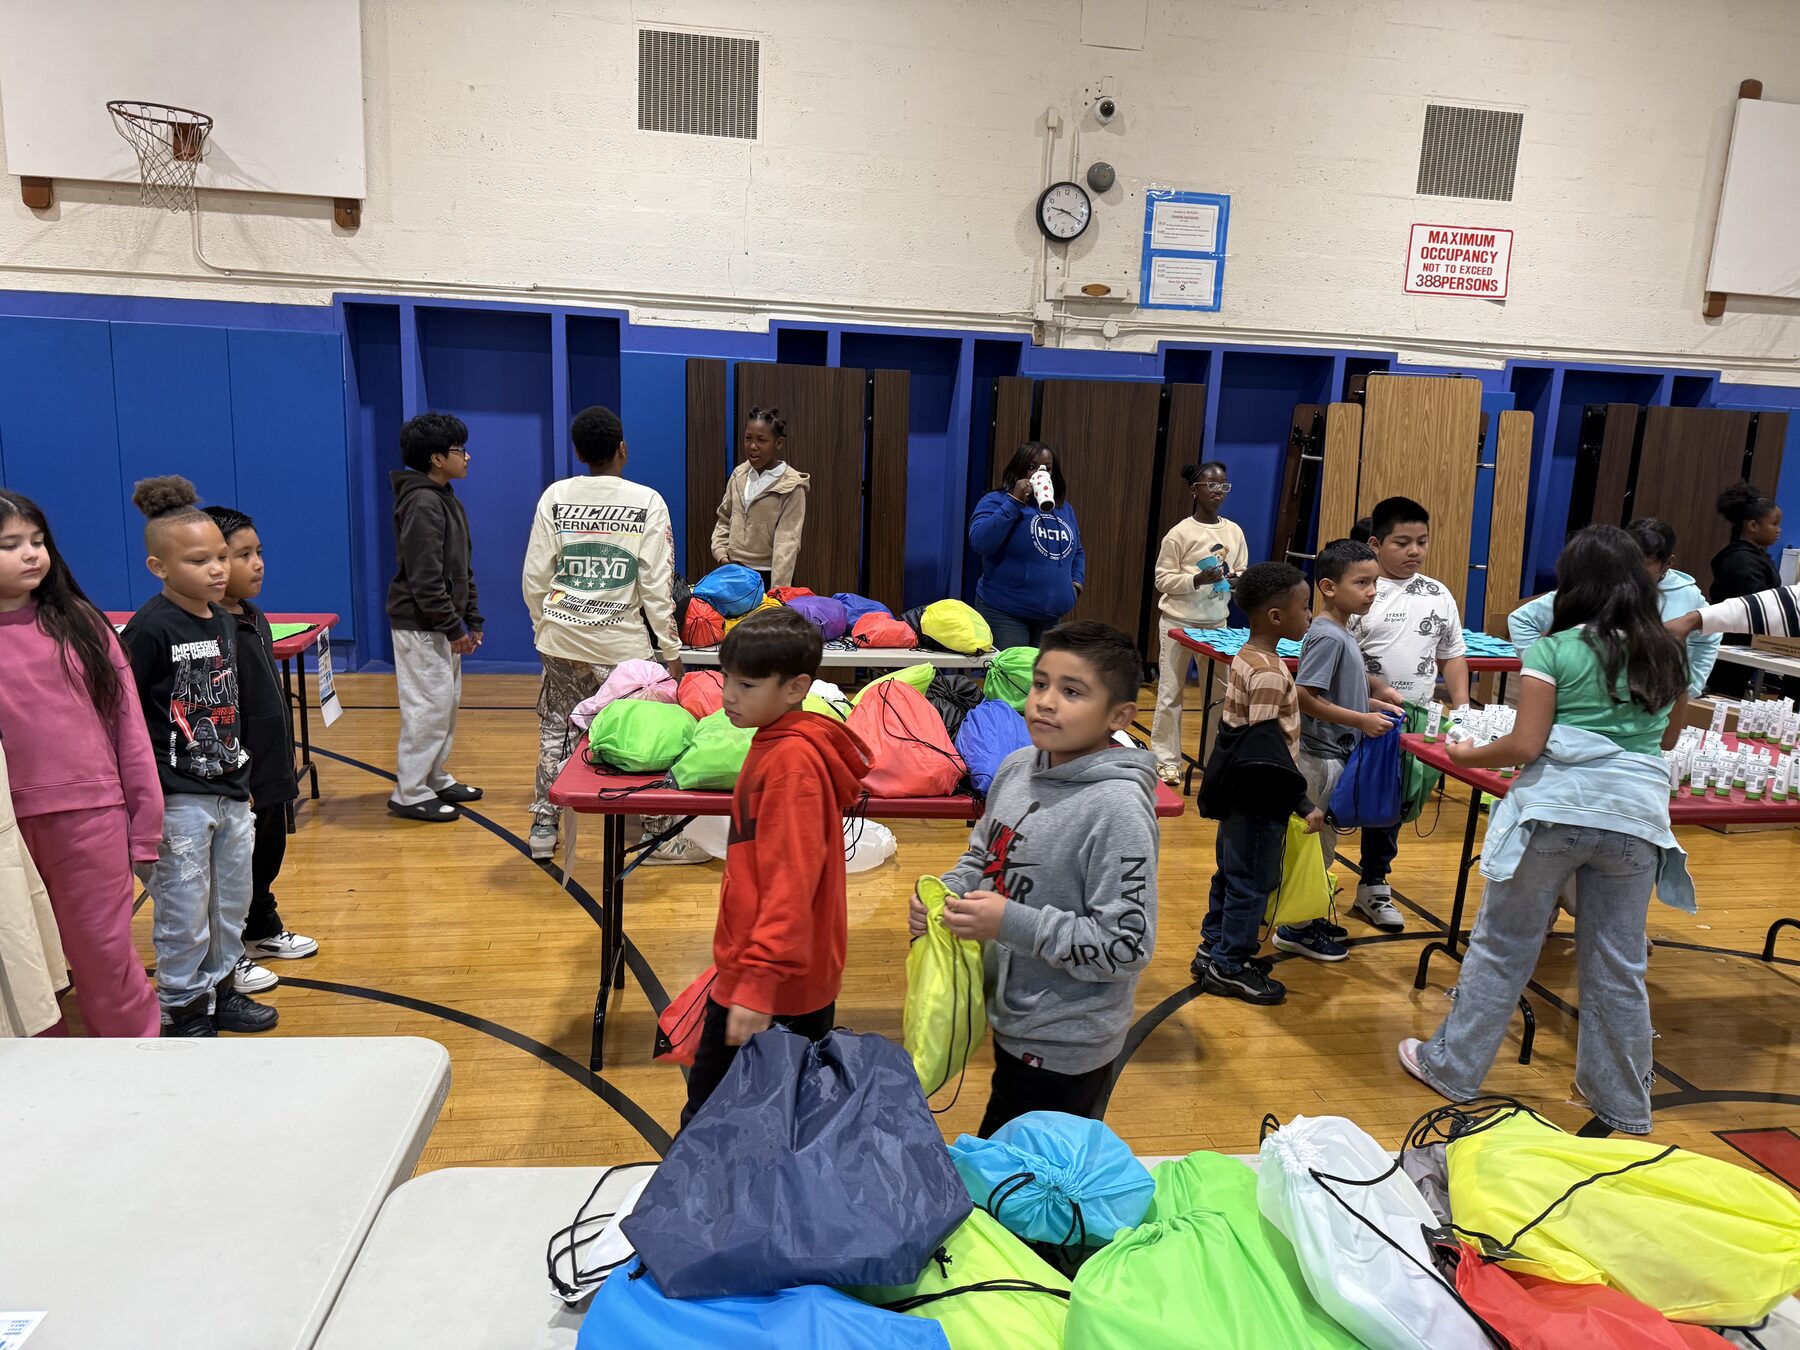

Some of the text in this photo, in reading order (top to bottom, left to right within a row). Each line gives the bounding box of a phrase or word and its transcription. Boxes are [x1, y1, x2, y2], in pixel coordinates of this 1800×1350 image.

[1427, 230, 1496, 248] MAXIMUM
[1420, 246, 1499, 264] OCCUPANCY
[1422, 262, 1493, 276] NOT TO EXCEED
[555, 504, 641, 522] RACING
[171, 639, 220, 655] IMPRESSIVE
[670, 841, 687, 856] N
